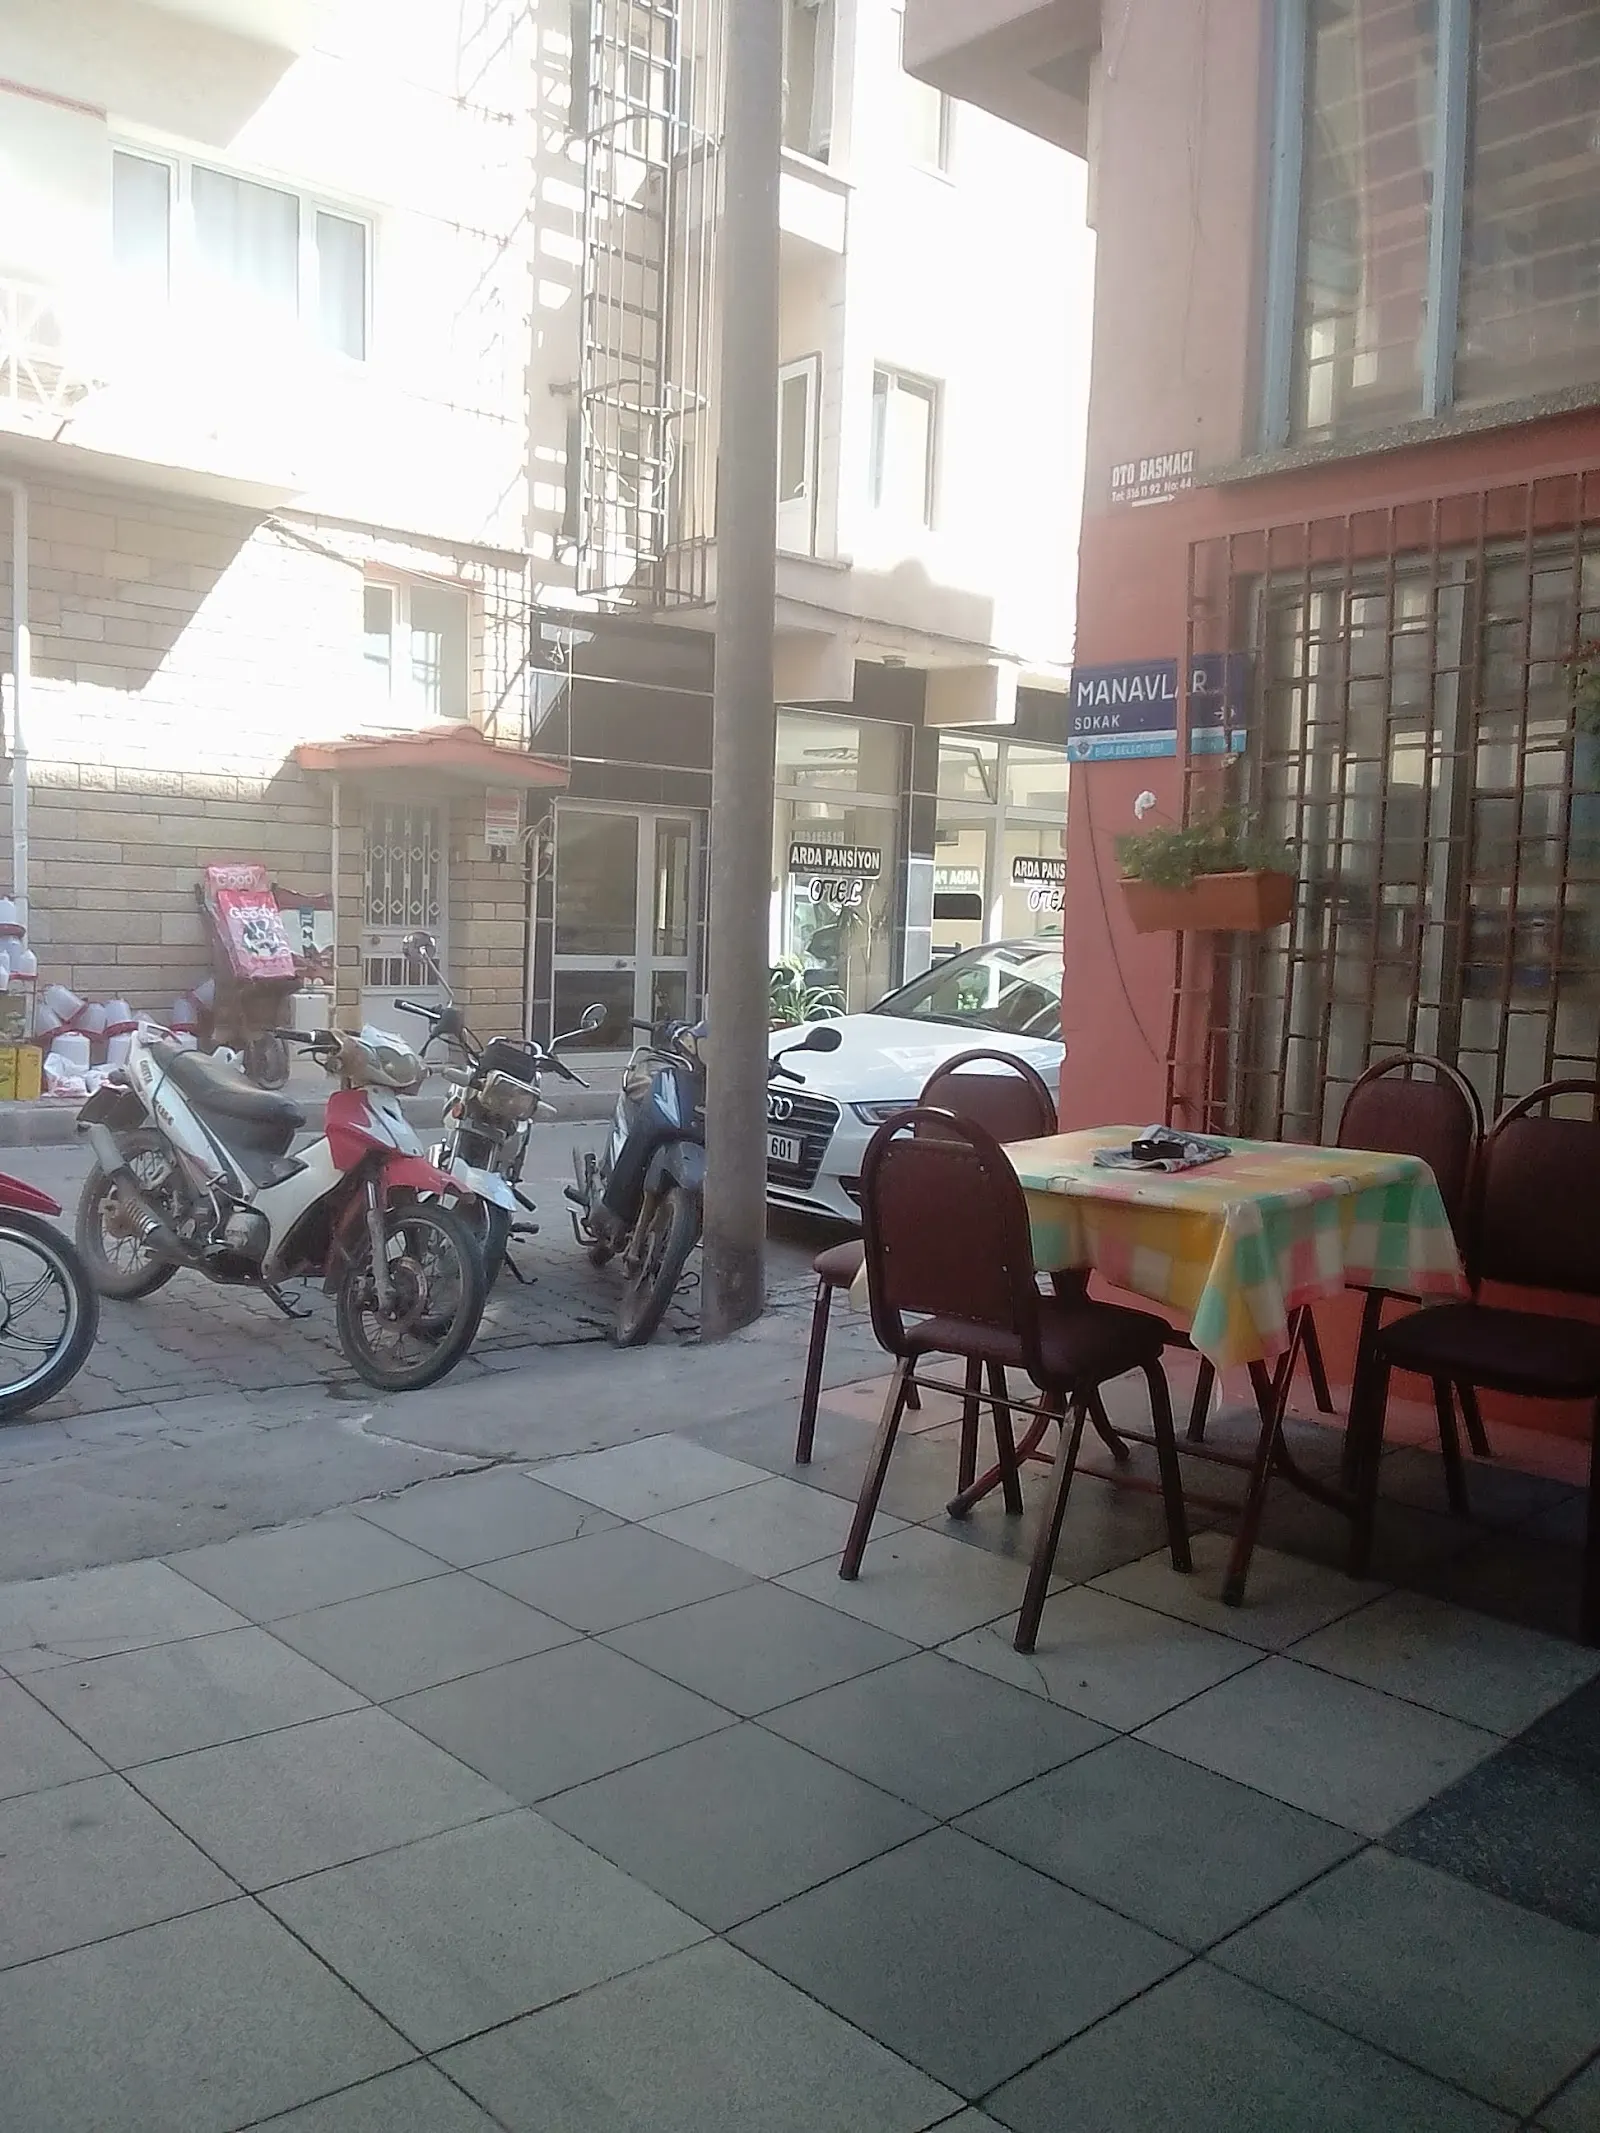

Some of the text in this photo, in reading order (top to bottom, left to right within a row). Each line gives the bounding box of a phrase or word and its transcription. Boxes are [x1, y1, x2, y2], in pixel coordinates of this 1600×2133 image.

[1112, 450, 1194, 487] OTO BASMACI
[1149, 483, 1161, 495] 92
[1180, 477, 1192, 489] 44
[1077, 670, 1208, 707] MANAVLR
[1074, 714, 1121, 730] SOKAK
[791, 846, 880, 869] ARDA PANSİYON
[1014, 860, 1040, 878] ARDA
[216, 869, 260, 888] Goody
[809, 876, 864, 907] OTEL
[771, 1137, 792, 1160] 601
